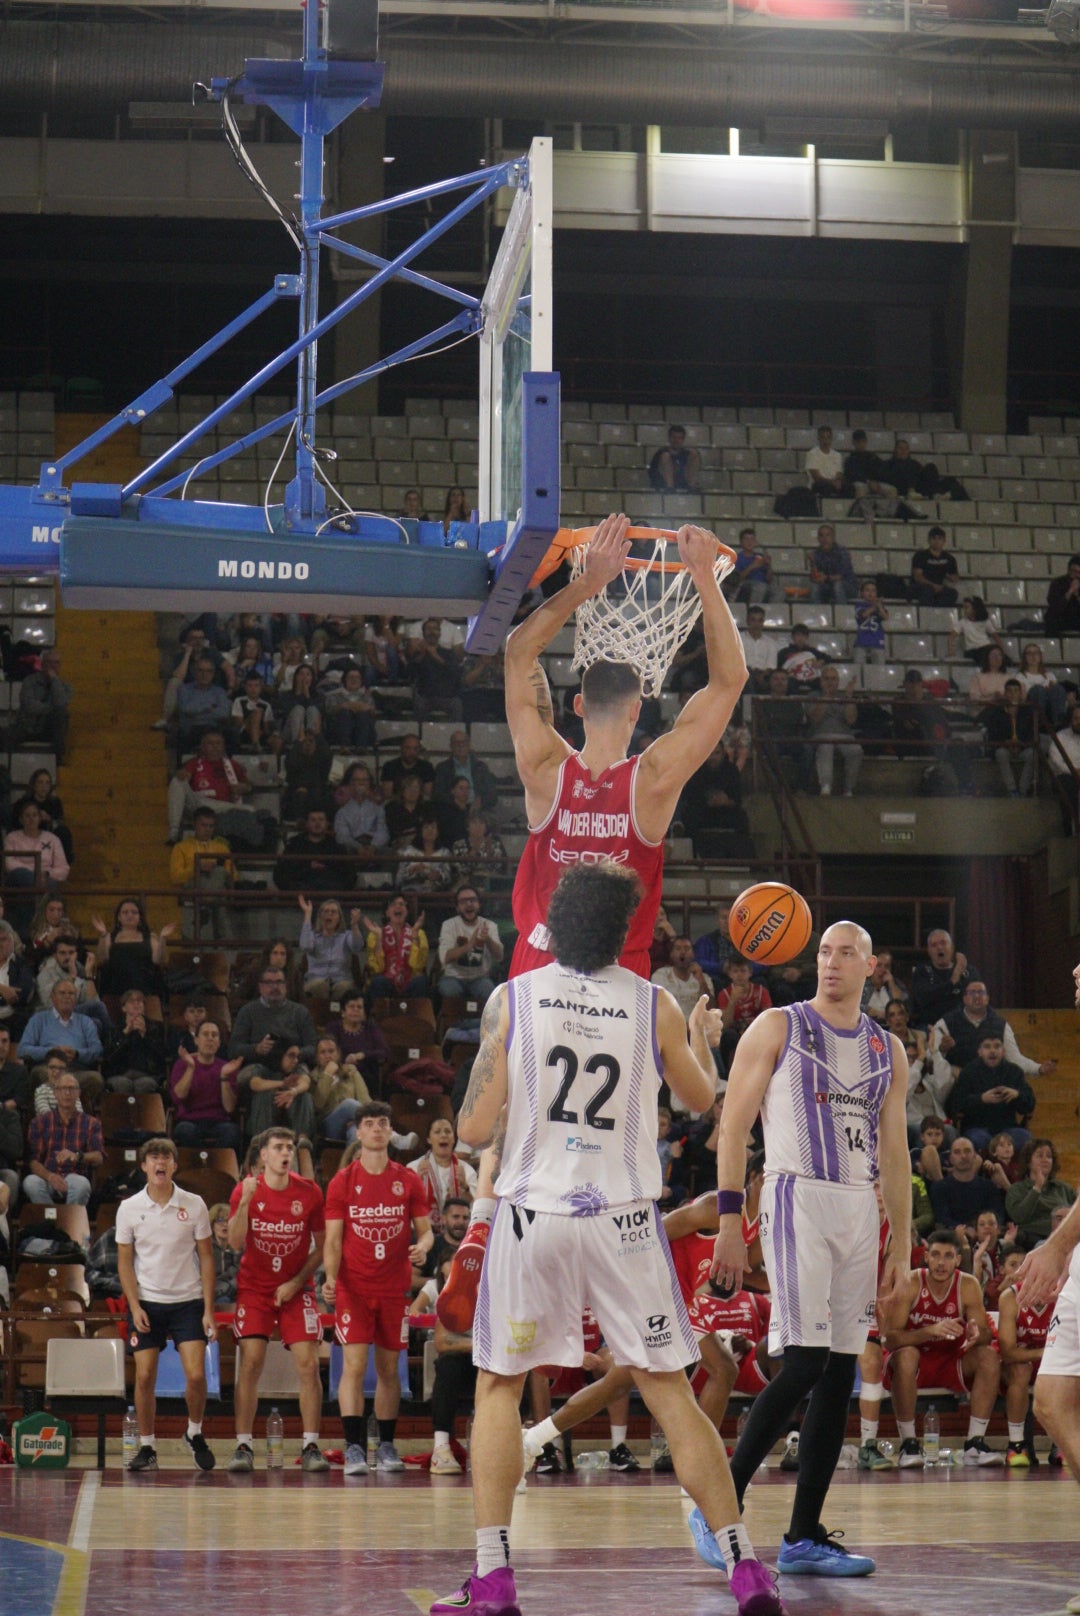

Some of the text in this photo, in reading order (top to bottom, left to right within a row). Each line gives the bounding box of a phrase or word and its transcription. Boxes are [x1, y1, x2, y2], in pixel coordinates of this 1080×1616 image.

[218, 559, 309, 580] MONDO
[746, 911, 786, 953] Wilson
[539, 999, 628, 1019] SANTANA
[546, 1045, 620, 1131] 22
[845, 1127, 866, 1152] 14
[349, 1203, 404, 1218] Ezedent
[251, 1218, 304, 1233] Ezedent
[374, 1243, 386, 1260] 8
[272, 1256, 282, 1273] 9
[24, 1439, 62, 1449] Gatorade
